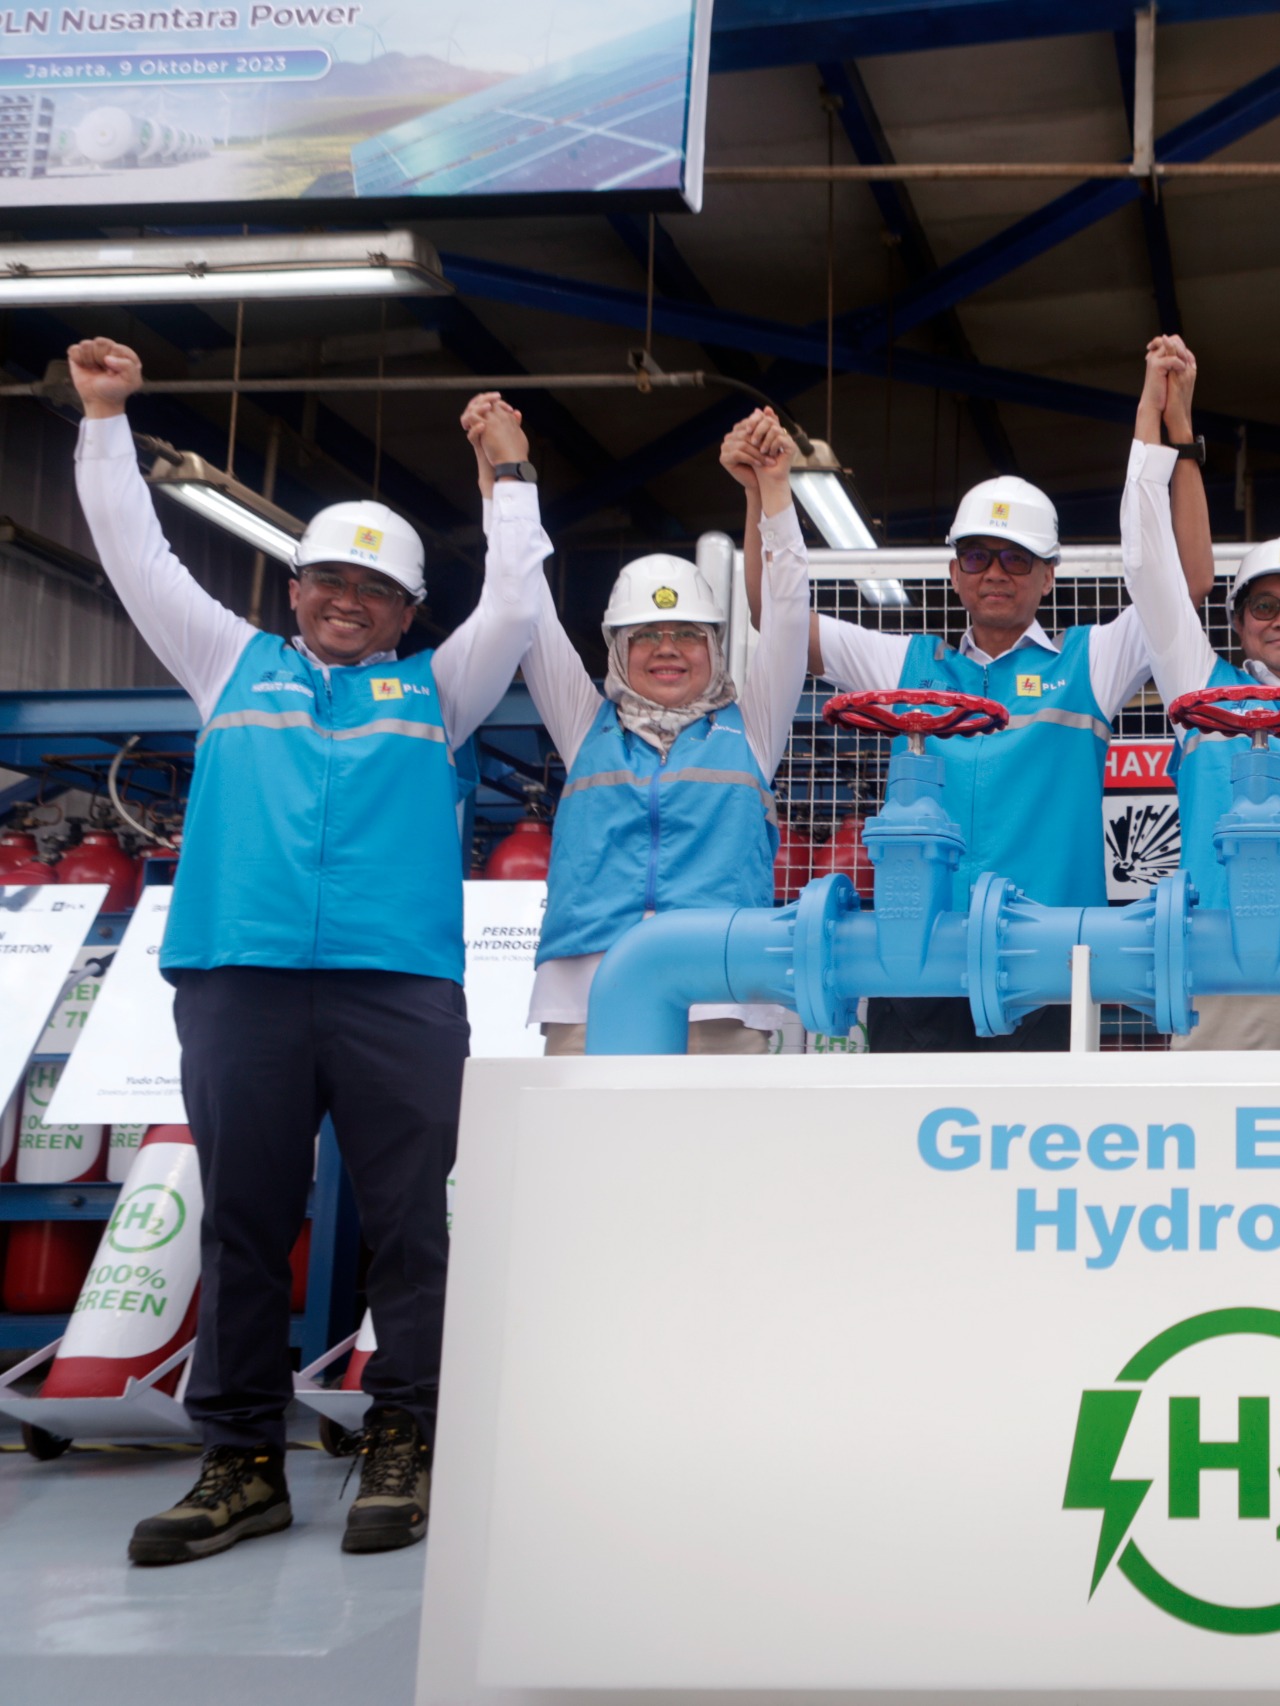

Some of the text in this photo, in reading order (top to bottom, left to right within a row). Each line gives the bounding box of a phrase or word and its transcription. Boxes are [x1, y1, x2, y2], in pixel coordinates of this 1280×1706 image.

[0, 3, 361, 34] LN Nusantara Power
[25, 55, 287, 80] Jakarta, 9 Oktober 2023
[989, 519, 1008, 528] PLN
[350, 548, 378, 562] PLN
[403, 684, 431, 696] PLN
[1043, 679, 1066, 691] PLN
[482, 926, 541, 936] PERESMI
[473, 940, 540, 950] HYDROGE
[916, 1106, 1197, 1172] Green
[86, 1263, 166, 1290] 100%
